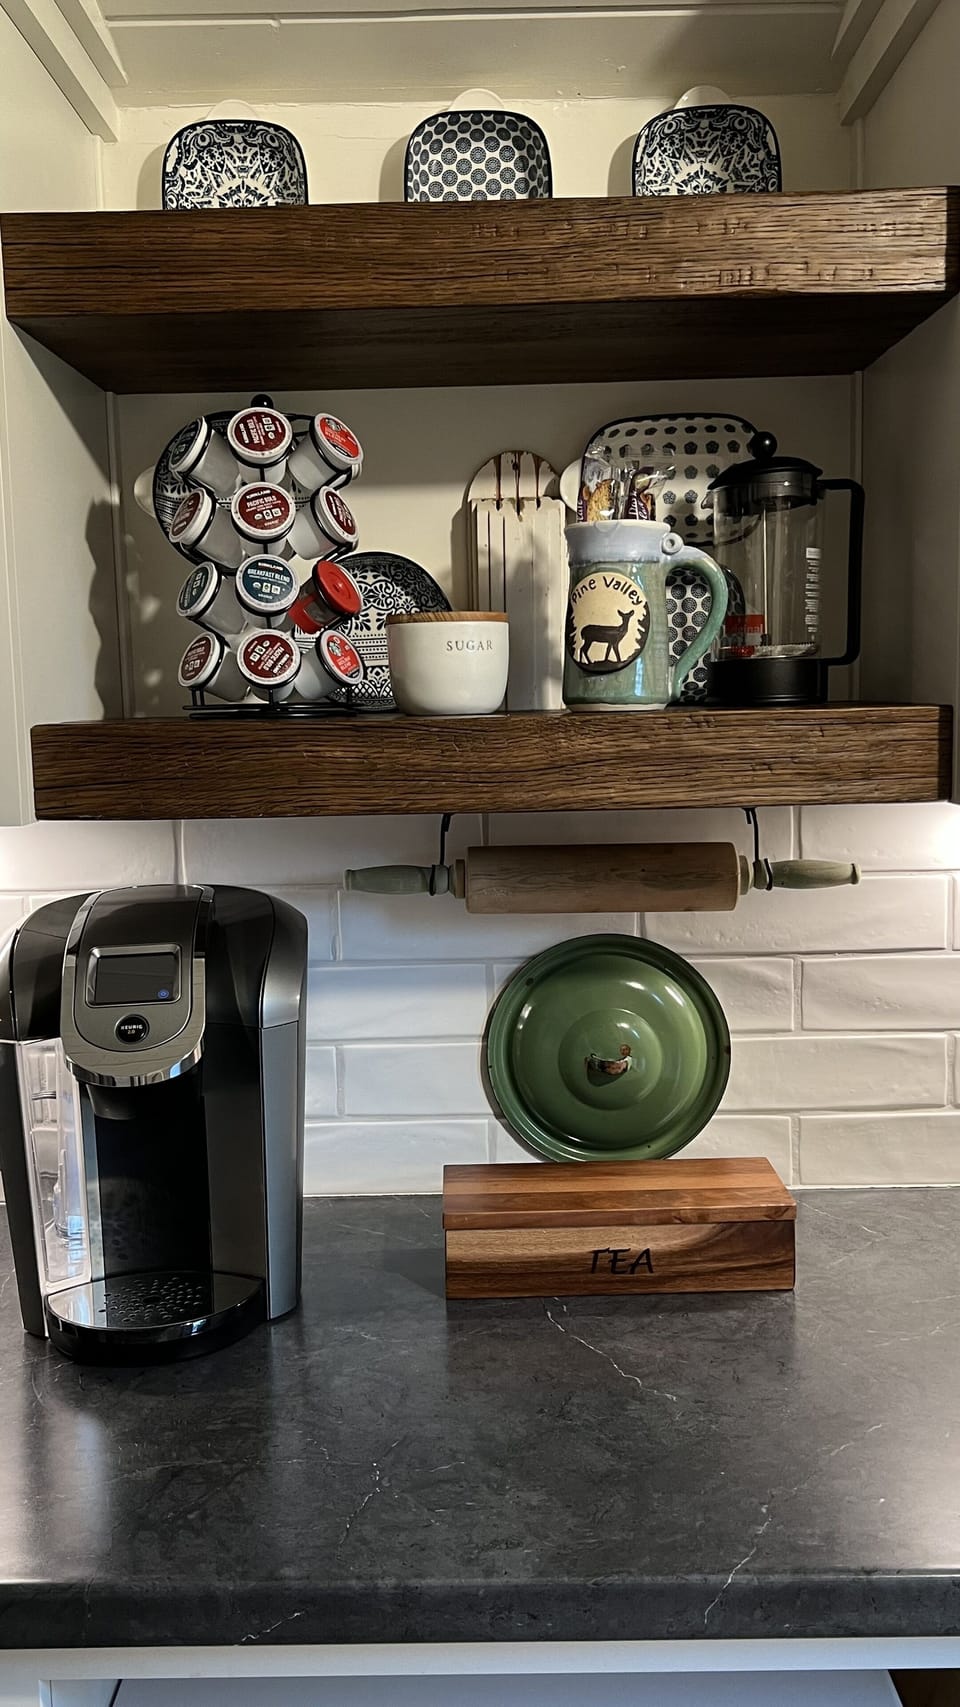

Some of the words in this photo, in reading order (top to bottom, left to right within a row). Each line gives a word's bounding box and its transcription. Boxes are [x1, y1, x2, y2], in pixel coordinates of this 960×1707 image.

[247, 568, 275, 579] BREAKFAST
[274, 573, 291, 583] BLEND
[571, 578, 597, 604] Pine
[602, 575, 643, 606] Valley
[446, 639, 493, 651] SUGAR
[587, 1246, 655, 1275] TEA
